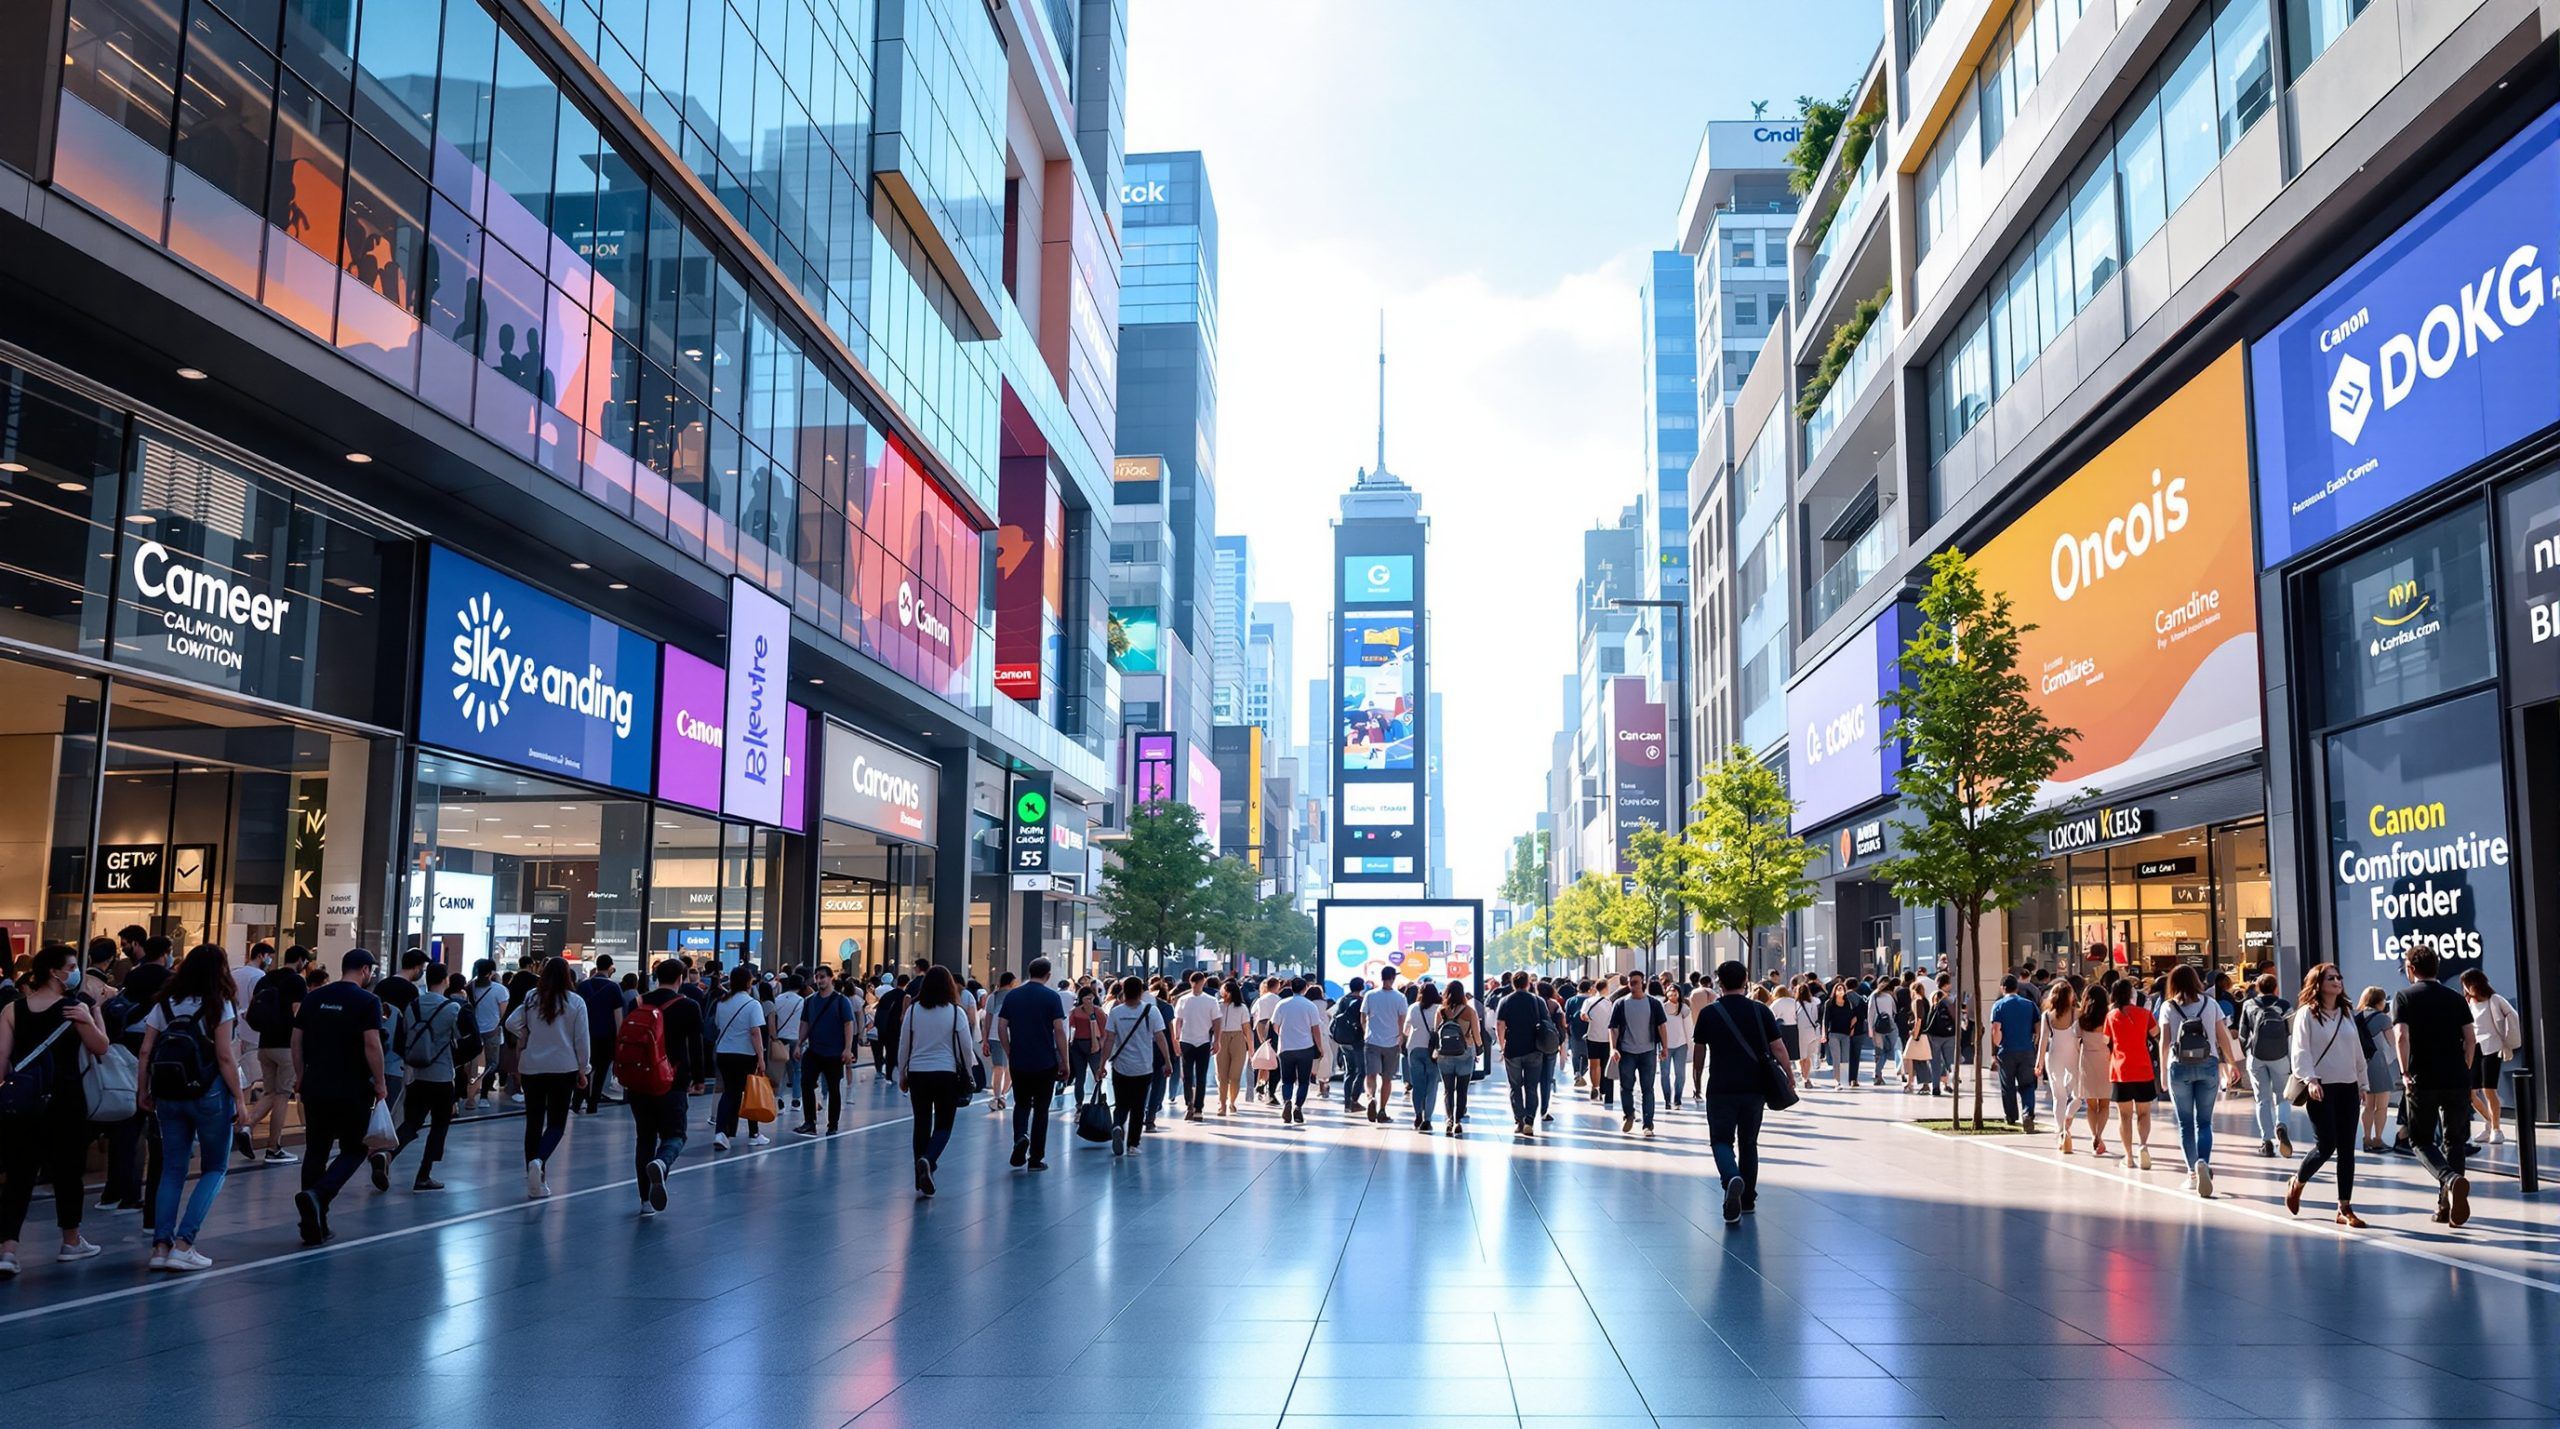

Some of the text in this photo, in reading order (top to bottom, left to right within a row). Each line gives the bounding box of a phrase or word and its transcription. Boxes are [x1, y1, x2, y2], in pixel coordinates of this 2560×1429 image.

[2320, 306, 2369, 352] Canon
[2379, 244, 2545, 411] DOKG
[2050, 468, 2189, 601] Oncois
[133, 541, 290, 635] Cameer
[541, 664, 634, 739] anding
[2369, 801, 2446, 837] Canon
[2339, 832, 2509, 884] Comfrountire
[2371, 881, 2461, 920] Forider
